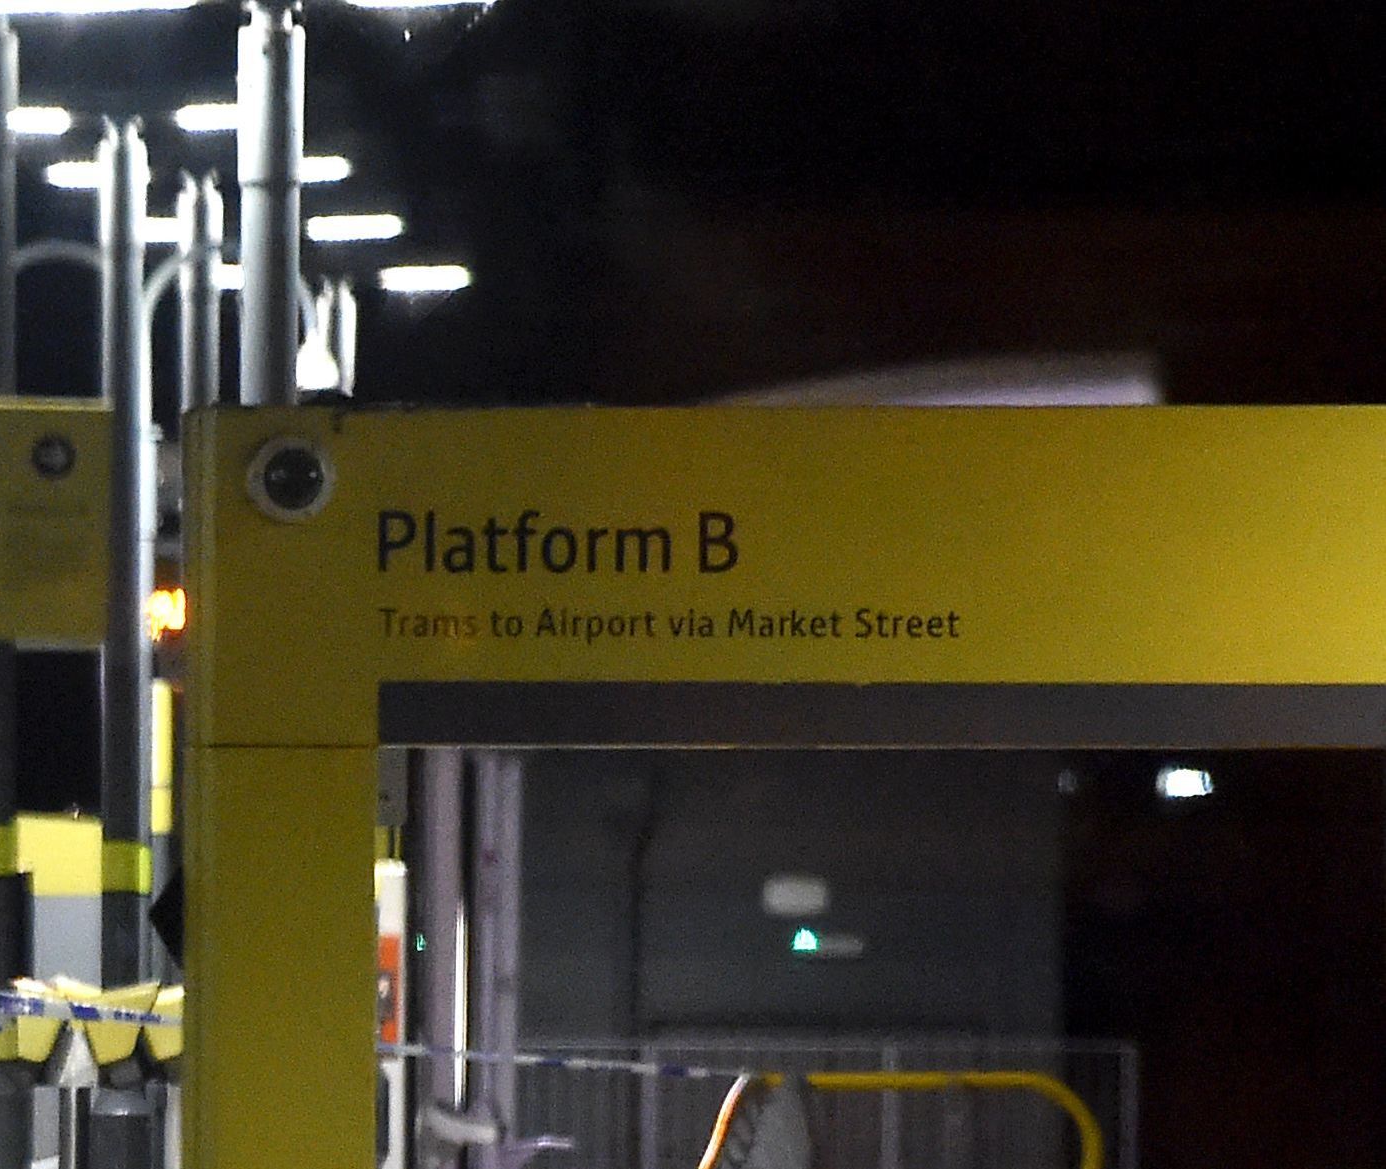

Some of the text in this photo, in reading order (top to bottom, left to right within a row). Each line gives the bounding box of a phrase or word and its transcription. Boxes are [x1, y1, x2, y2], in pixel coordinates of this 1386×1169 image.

[377, 509, 739, 574] Platform B
[379, 607, 961, 645] Trams to Airport via Market Street
